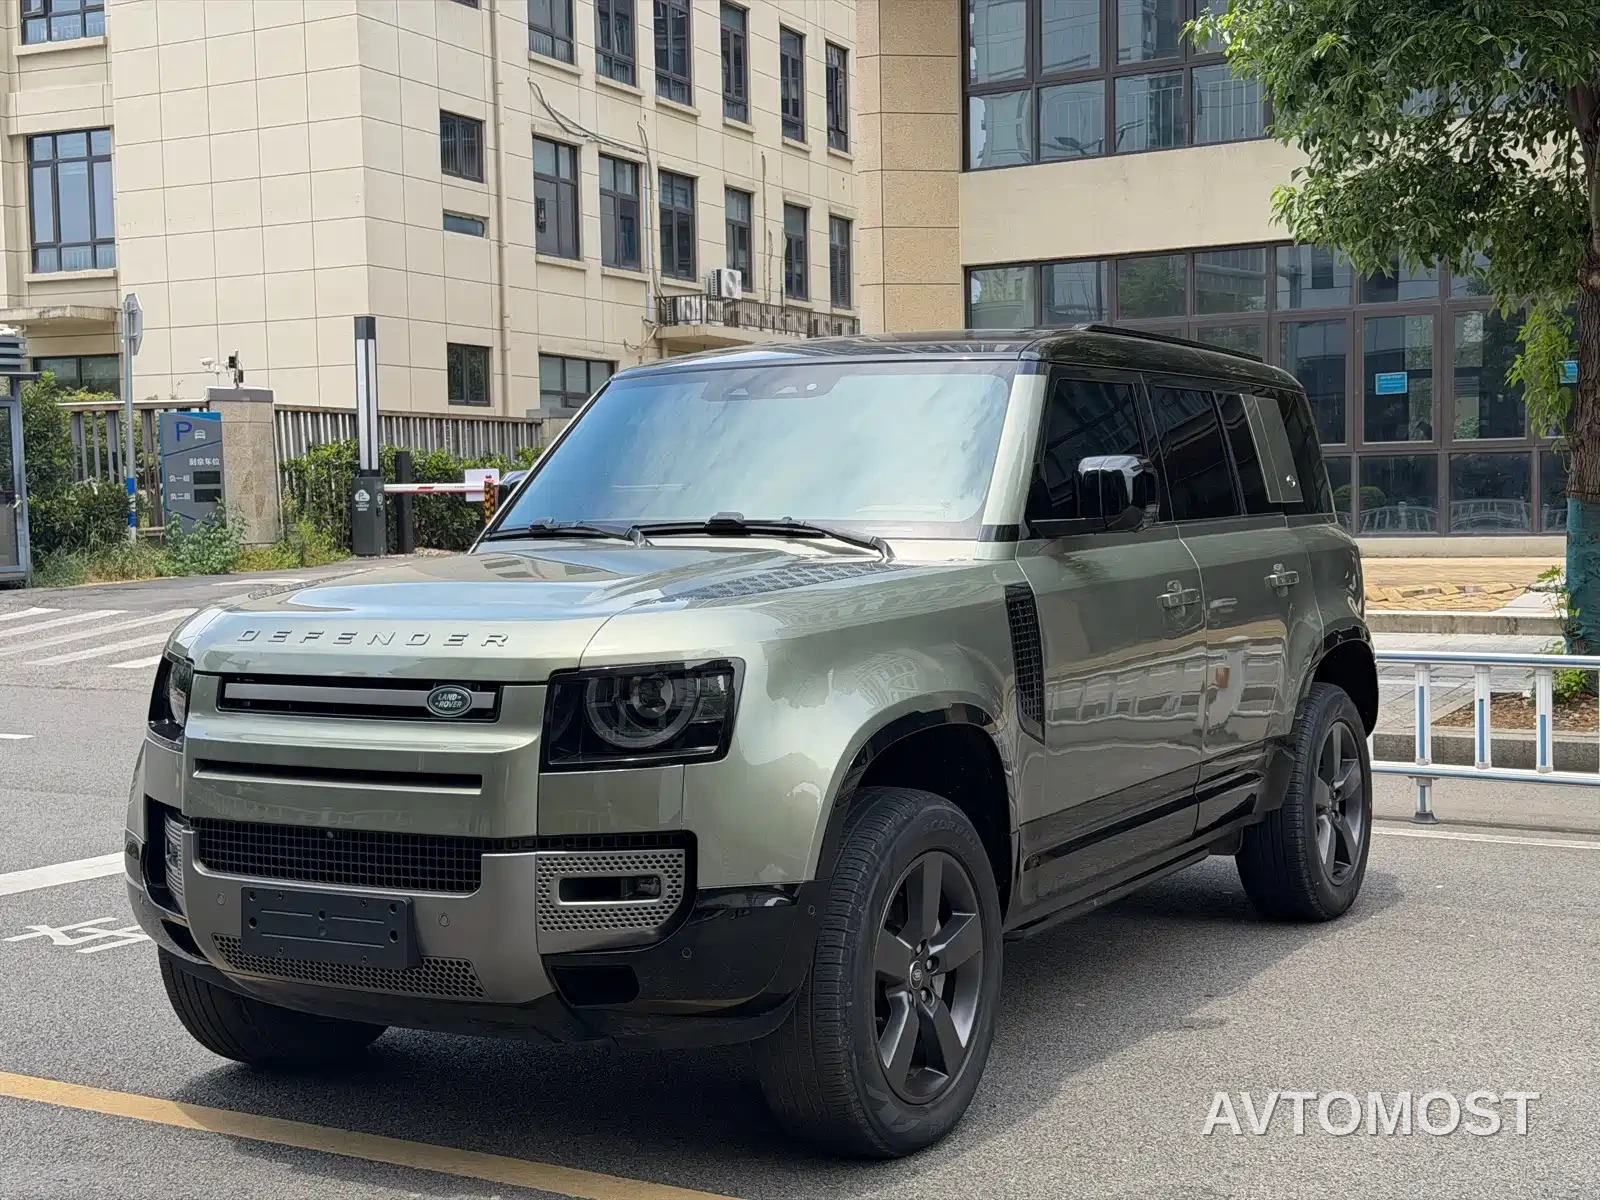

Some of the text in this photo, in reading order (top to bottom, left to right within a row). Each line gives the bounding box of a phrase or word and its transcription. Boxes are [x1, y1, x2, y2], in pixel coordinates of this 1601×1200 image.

[174, 421, 193, 442] P
[236, 629, 509, 648] DEFENDER
[437, 693, 458, 701] LAND
[438, 700, 463, 708] ROVER
